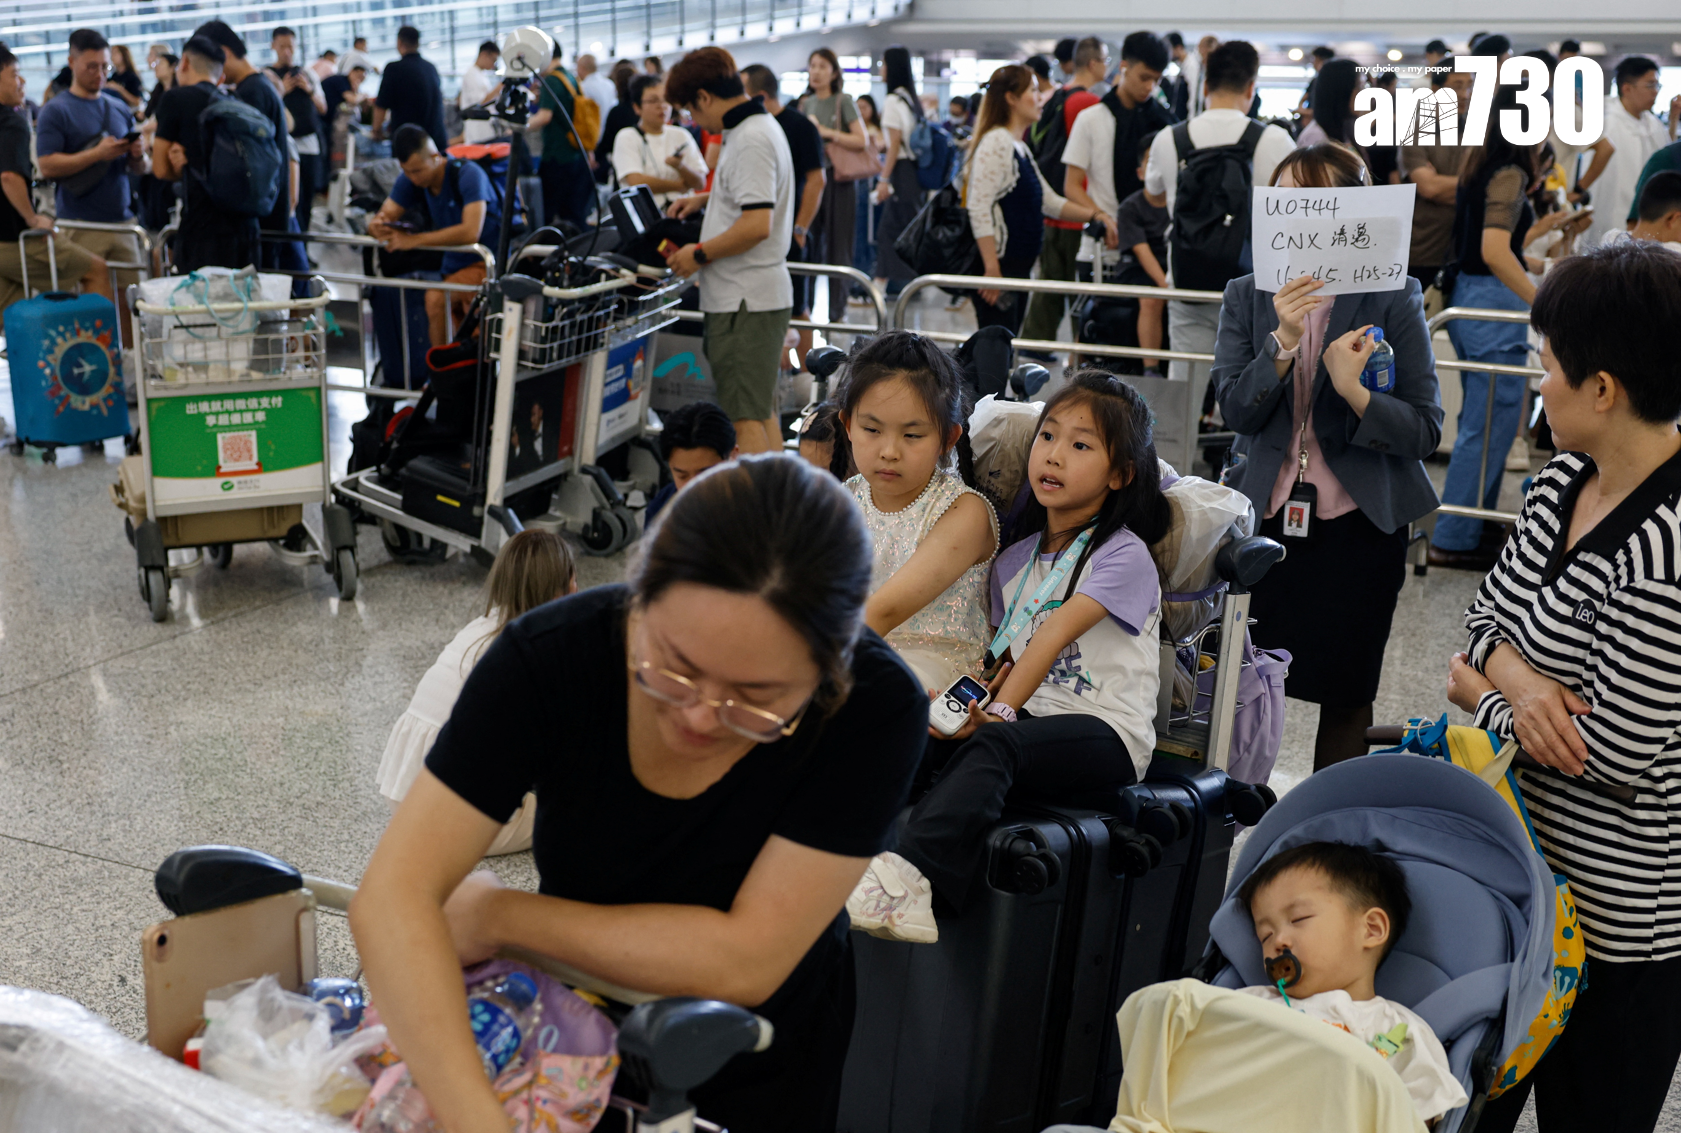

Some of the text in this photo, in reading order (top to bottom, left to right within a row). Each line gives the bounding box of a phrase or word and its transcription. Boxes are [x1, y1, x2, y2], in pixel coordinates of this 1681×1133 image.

[1271, 232, 1323, 250] CNX
[1353, 263, 1403, 284] H25-27
[1575, 602, 1595, 624] Leo
